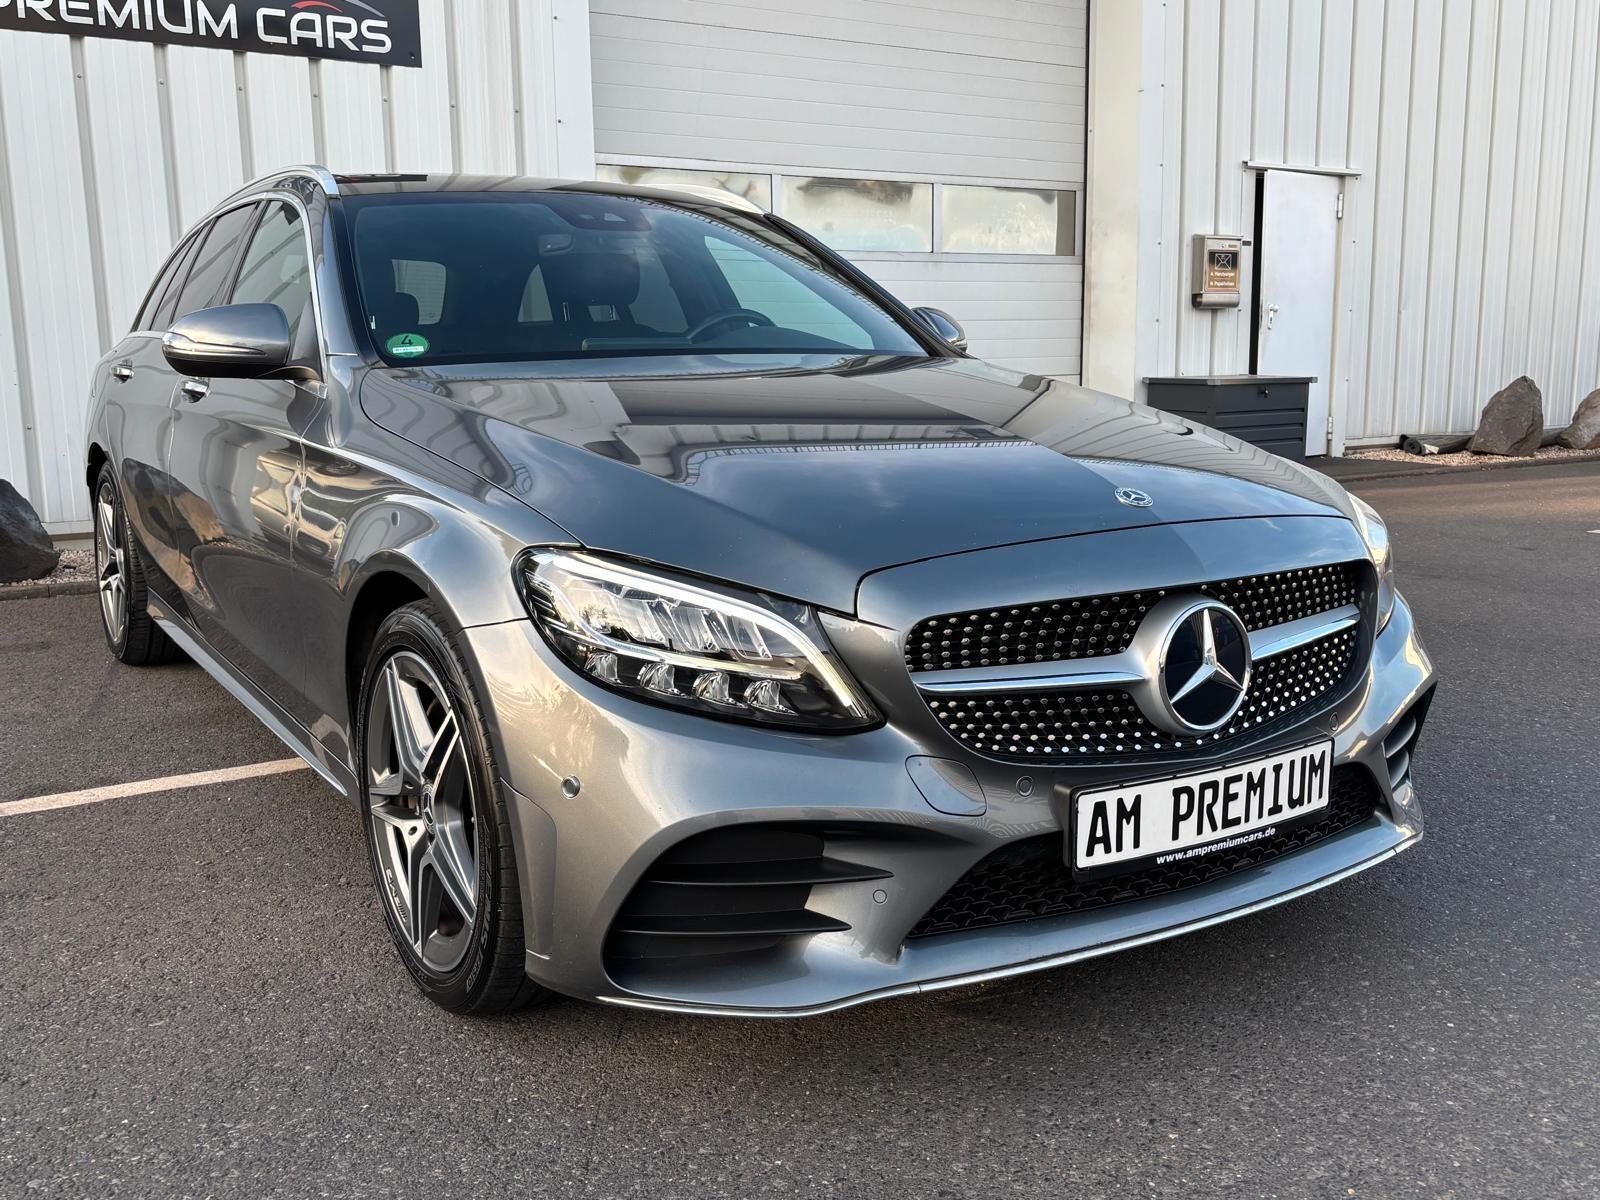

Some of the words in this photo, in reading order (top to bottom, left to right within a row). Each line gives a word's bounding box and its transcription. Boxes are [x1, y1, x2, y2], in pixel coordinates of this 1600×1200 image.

[0, 0, 239, 39] REMIUM
[256, 9, 393, 54] CARS
[401, 335, 414, 346] 4
[1086, 794, 1142, 857] AM
[1172, 750, 1326, 841] PREMIUM
[1156, 827, 1276, 865] www.ampremiumcars.de
